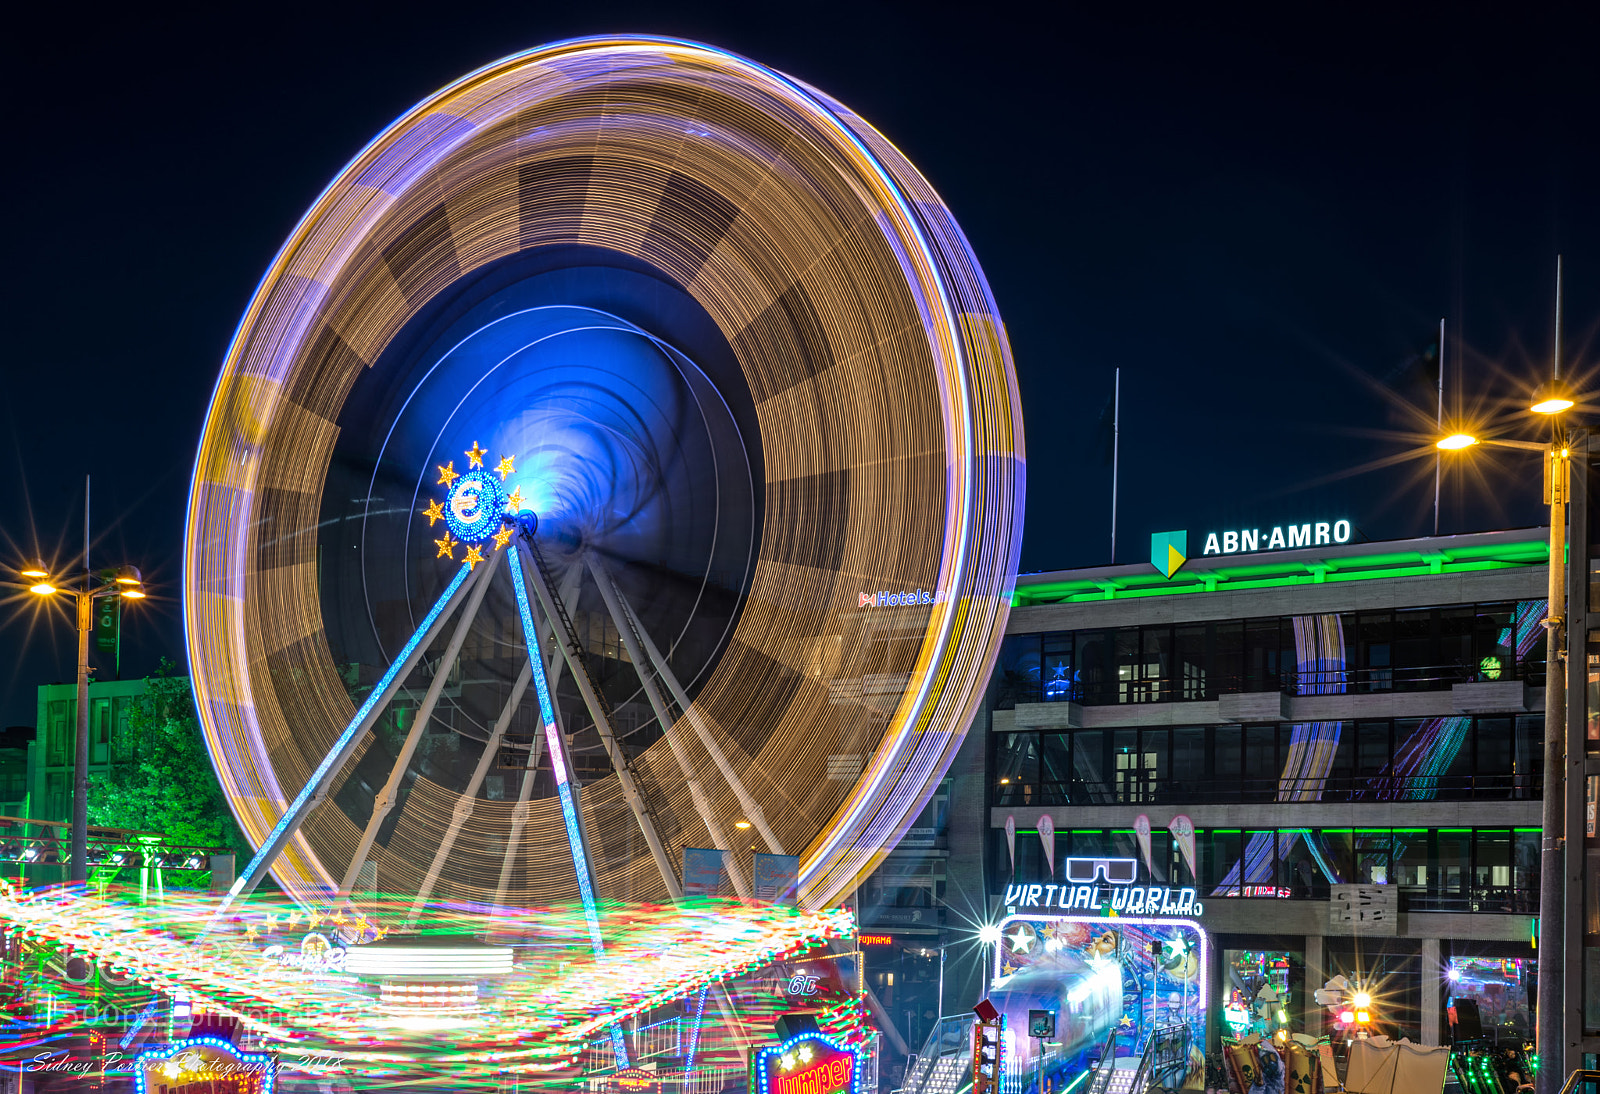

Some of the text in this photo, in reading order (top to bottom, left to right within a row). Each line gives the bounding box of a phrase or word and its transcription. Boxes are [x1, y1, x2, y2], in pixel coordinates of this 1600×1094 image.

[1004, 884, 1196, 911] VIRTUAL WORLD
[858, 936, 892, 946] FUJIYAMA
